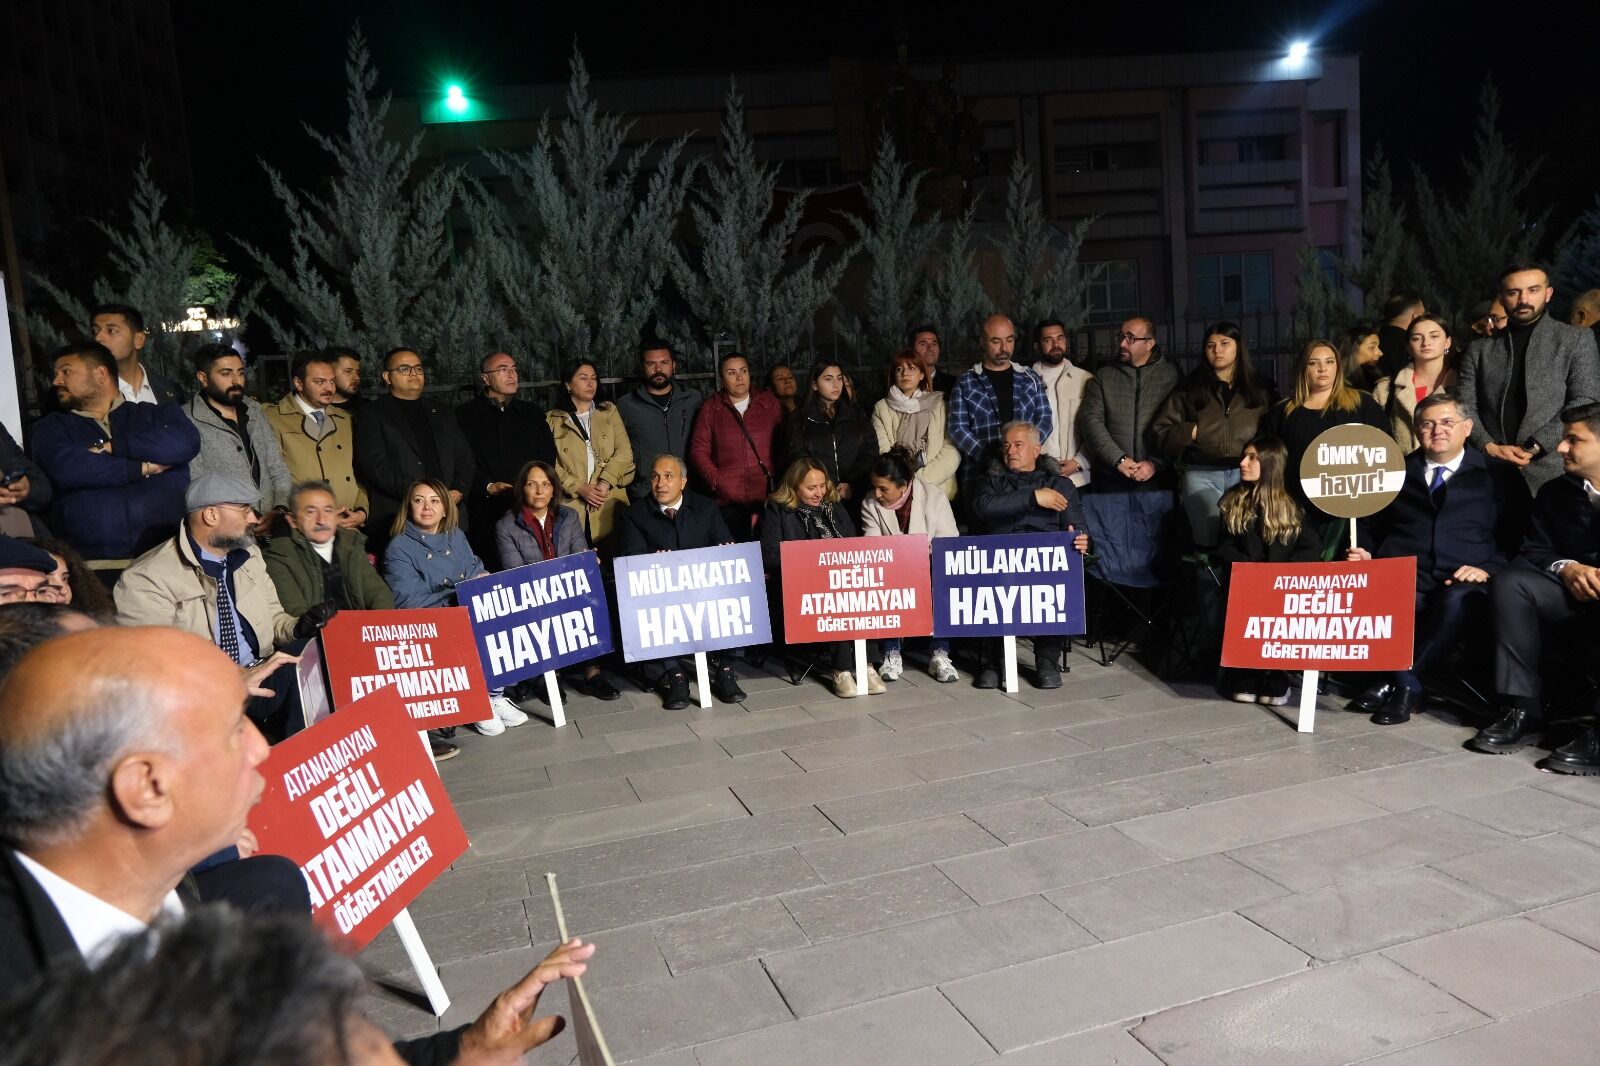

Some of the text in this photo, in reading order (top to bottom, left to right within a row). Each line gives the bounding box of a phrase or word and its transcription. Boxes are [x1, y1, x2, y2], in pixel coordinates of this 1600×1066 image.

[1317, 444, 1387, 467] ÖMK'ya
[1320, 468, 1385, 499] hayır!
[818, 549, 894, 567] ATANAMAYAN
[945, 545, 1069, 576] MÜLAKATA
[628, 558, 751, 597] MÜLAKATA
[828, 564, 884, 590] DEĞİL!
[1273, 573, 1368, 590] ATANAMAYAN
[471, 568, 592, 624] MÜLAKATA
[800, 588, 916, 616] ATANMAYAN
[950, 584, 1066, 626] HAYIR!
[1283, 590, 1354, 616] DEĞİL!
[361, 623, 438, 643] ATANAMAYAN
[637, 596, 753, 648] HAYIR!
[817, 614, 901, 633] ÖĞRETMENLER
[1244, 615, 1392, 640] ATANMAYAN
[374, 640, 434, 671] DEĞİL!
[485, 607, 598, 677] HAYIR!
[1261, 641, 1369, 660] ÖĞRETMENLER
[404, 697, 460, 719] TMENLER
[282, 724, 378, 802] ATANAMAYAN
[309, 761, 386, 840] DEĞİL!
[332, 835, 434, 935] ÖĞRETMENLER
